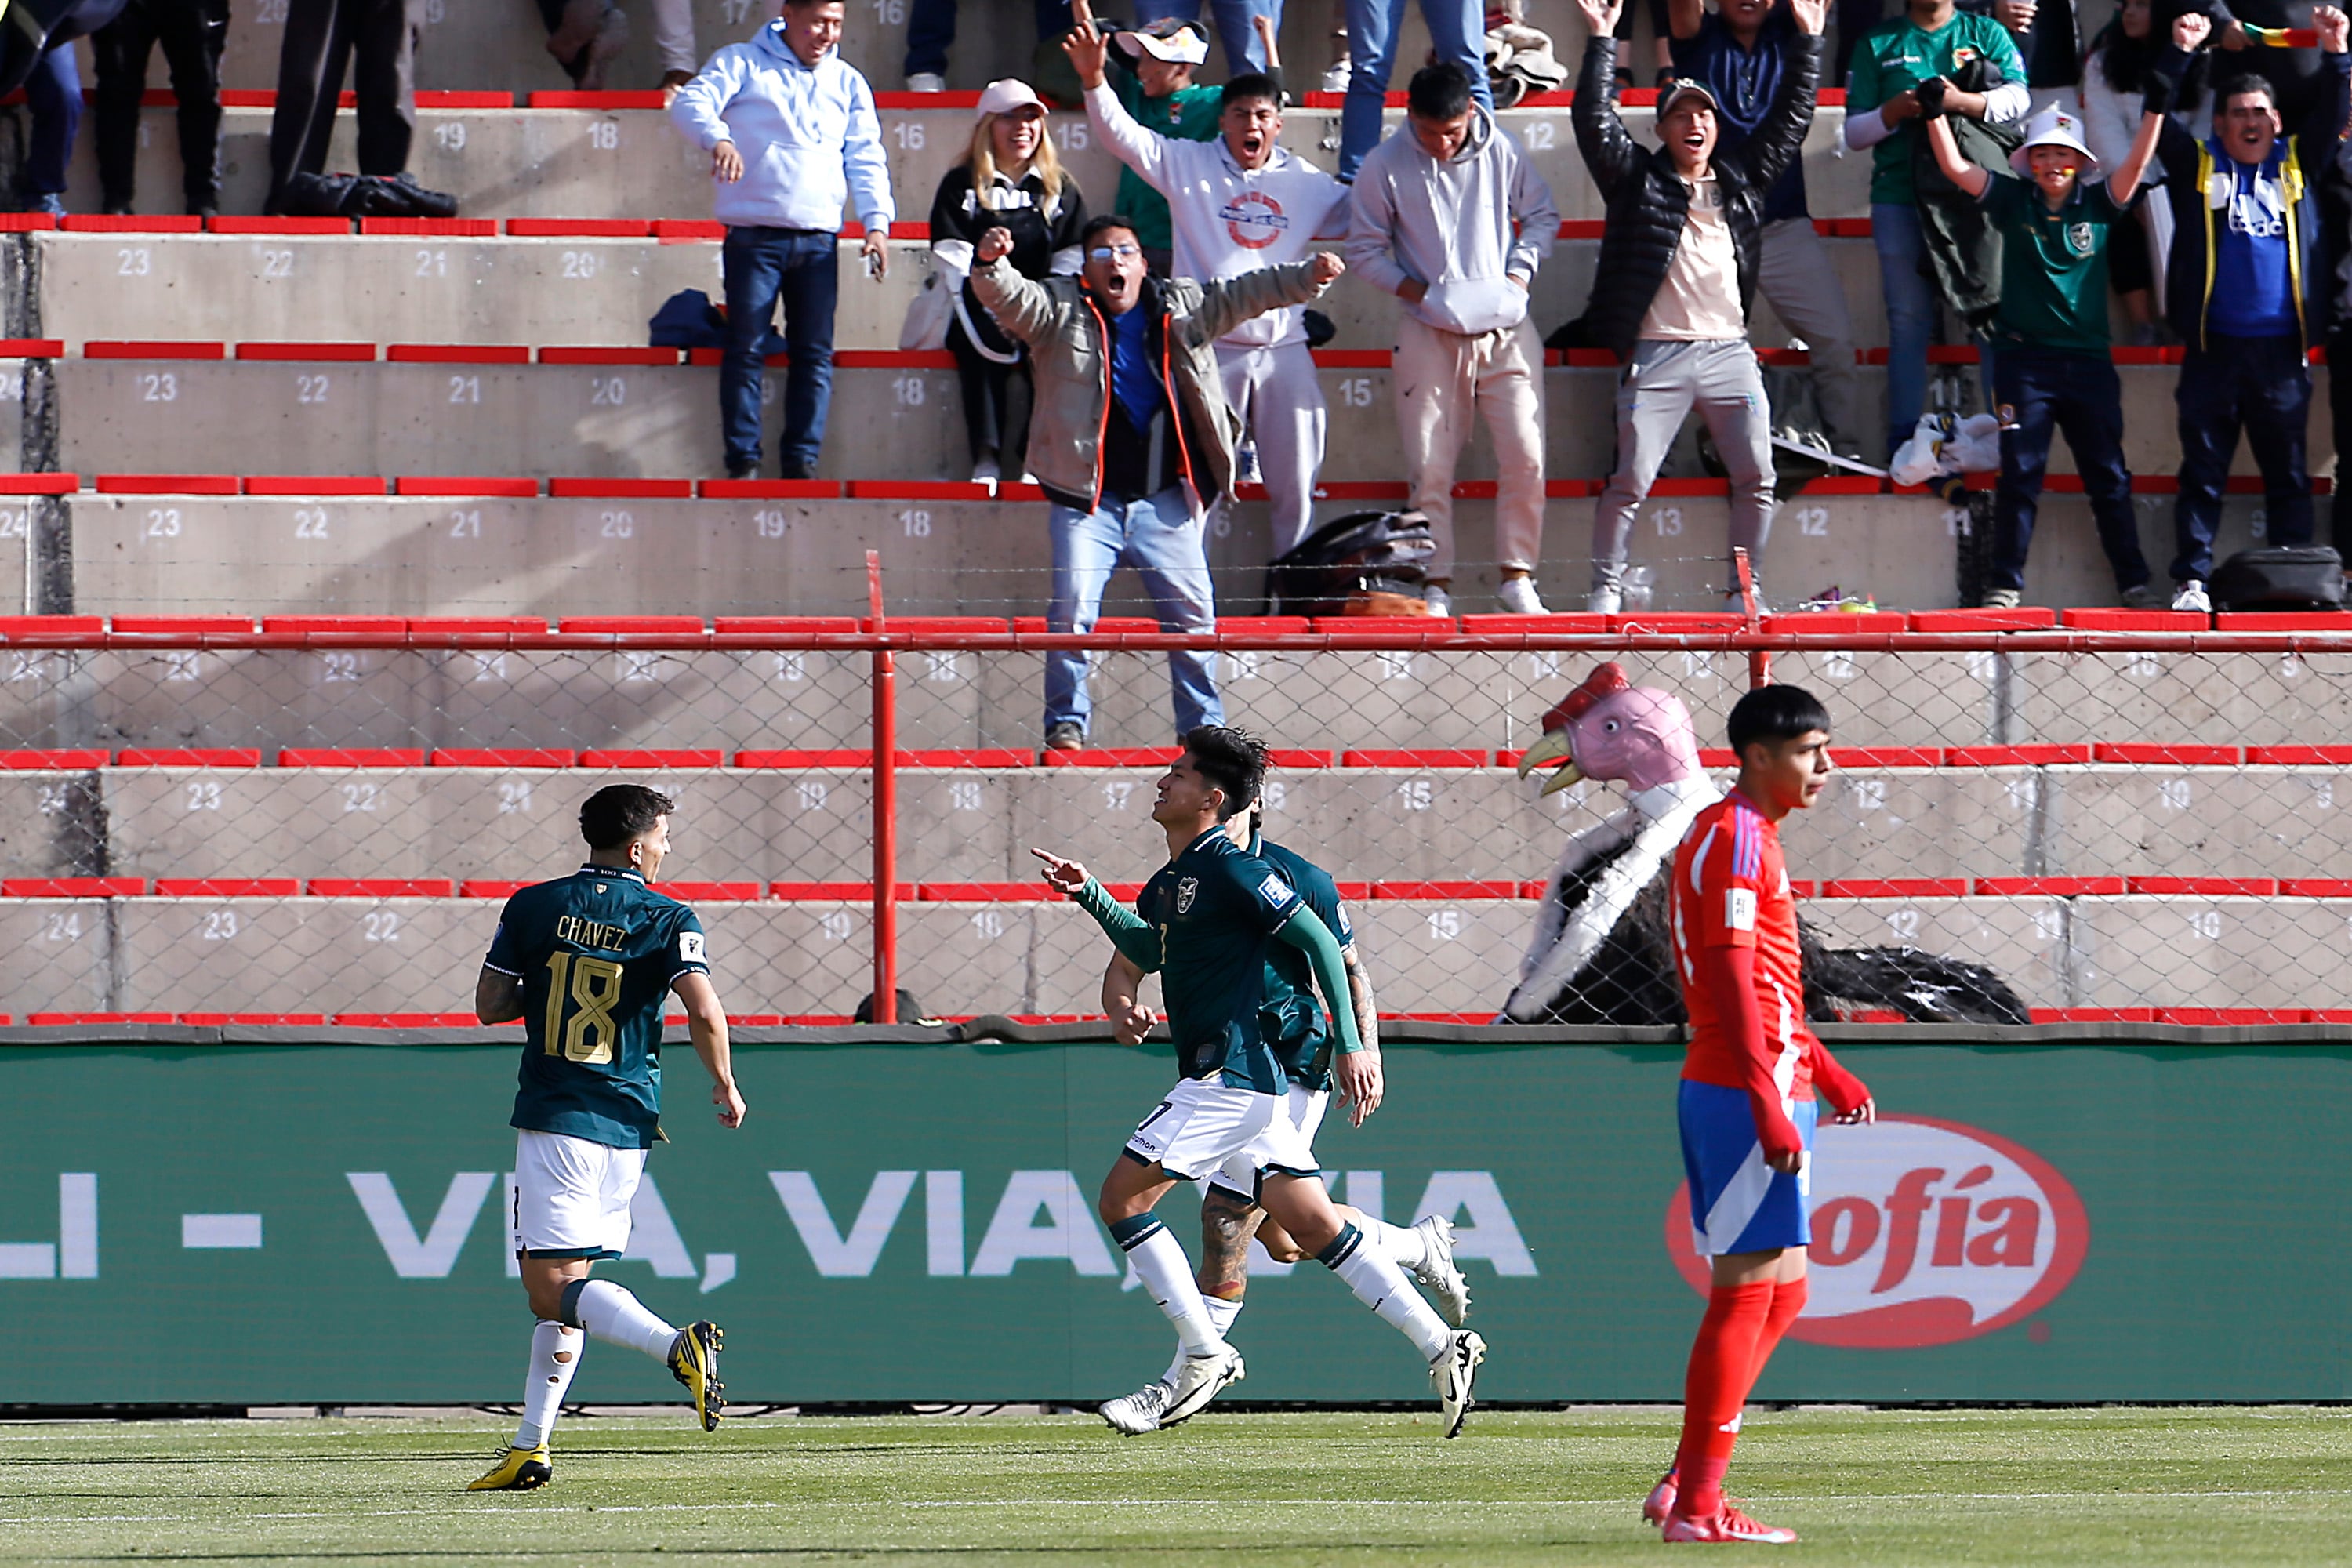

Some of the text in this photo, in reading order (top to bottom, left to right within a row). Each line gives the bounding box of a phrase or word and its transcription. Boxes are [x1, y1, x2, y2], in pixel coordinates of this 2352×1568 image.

[872, 0, 904, 25] 16
[434, 122, 466, 151] 19
[586, 122, 619, 150] 18
[893, 122, 925, 151] 16
[1056, 122, 1088, 150] 15
[1523, 122, 1555, 150] 12
[117, 249, 151, 277] 23
[263, 250, 294, 277] 22
[415, 249, 448, 277] 21
[561, 251, 595, 278] 20
[143, 374, 176, 401] 23
[296, 375, 330, 403] 22
[449, 376, 481, 403] 21
[590, 377, 625, 405] 20
[891, 377, 924, 405] 18
[1339, 379, 1373, 406] 15
[0, 510, 26, 538] 24
[147, 509, 182, 536] 23
[294, 510, 328, 539] 22
[449, 510, 481, 538] 21
[600, 511, 633, 539] 20
[753, 510, 786, 539] 19
[898, 510, 931, 537] 18
[1649, 507, 1682, 536] 13
[1795, 507, 1828, 536] 12
[1940, 508, 1972, 537] 11
[324, 653, 358, 682] 22
[1226, 651, 1259, 681] 16
[1378, 651, 1413, 680] 15
[1528, 651, 1560, 680] 14
[1682, 650, 1714, 678] 13
[1821, 650, 1854, 679] 12
[1966, 651, 1999, 679] 11
[2125, 651, 2158, 677] 10
[187, 782, 223, 811] 23
[343, 782, 378, 812] 22
[498, 781, 531, 814] 21
[795, 781, 828, 811] 19
[949, 781, 982, 811] 18
[1398, 781, 1432, 812] 15
[1853, 780, 1886, 809] 12
[2005, 780, 2038, 809] 11
[2158, 779, 2192, 810] 10
[49, 912, 81, 942] 24
[203, 911, 238, 941] 23
[364, 912, 398, 942] 22
[557, 915, 626, 951] CHAVEZ
[818, 911, 851, 941] 19
[970, 909, 1004, 940] 18
[1426, 909, 1460, 940] 15
[1884, 909, 1919, 940] 12
[2031, 909, 2062, 939] 11
[2188, 910, 2220, 940] 10
[544, 950, 624, 1065] 18
[1138, 1101, 1173, 1132] 7
[1806, 1164, 2040, 1294] ofía
